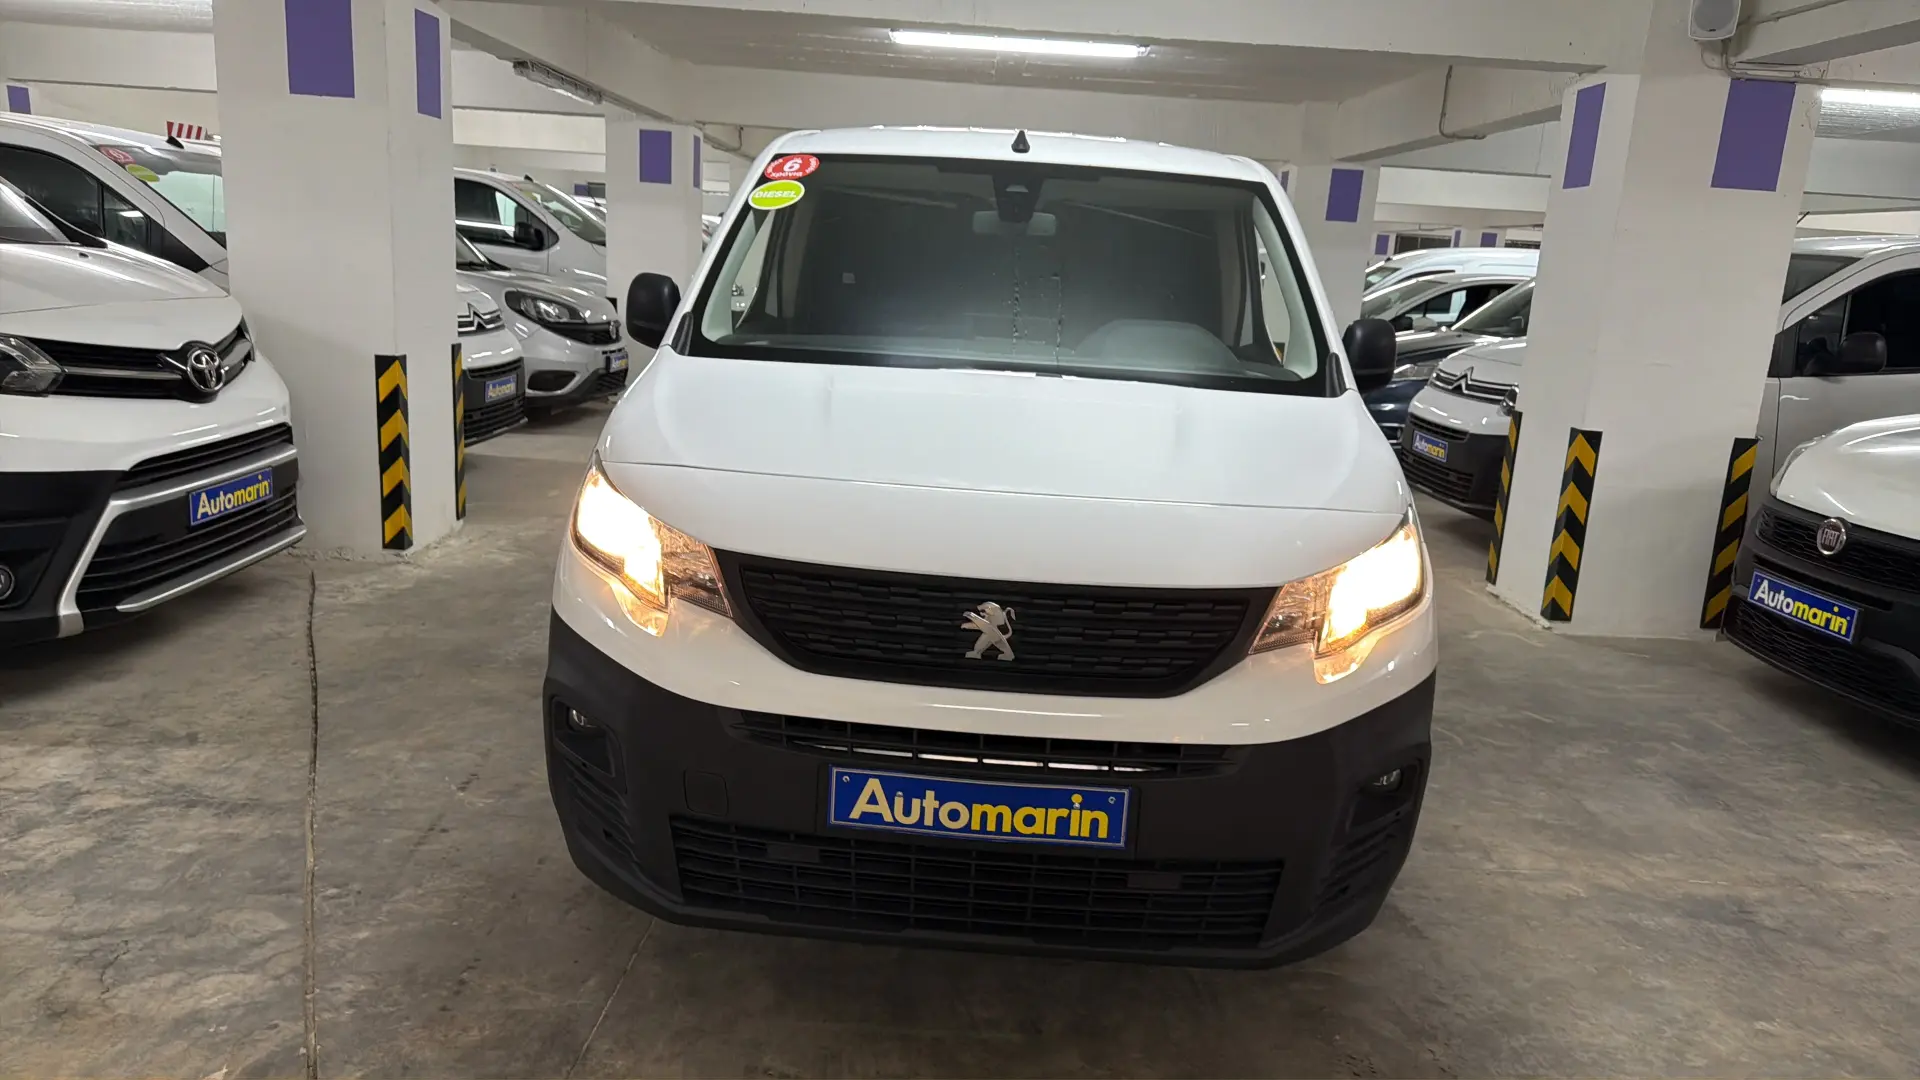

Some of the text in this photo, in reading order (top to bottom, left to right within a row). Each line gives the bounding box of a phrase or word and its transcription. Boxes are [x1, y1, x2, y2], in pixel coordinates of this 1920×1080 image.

[783, 158, 802, 172] 6
[753, 190, 797, 198] DIESEL
[197, 474, 270, 520] Automarin
[1753, 579, 1848, 636] Automarin
[849, 777, 1109, 839] Automarin
